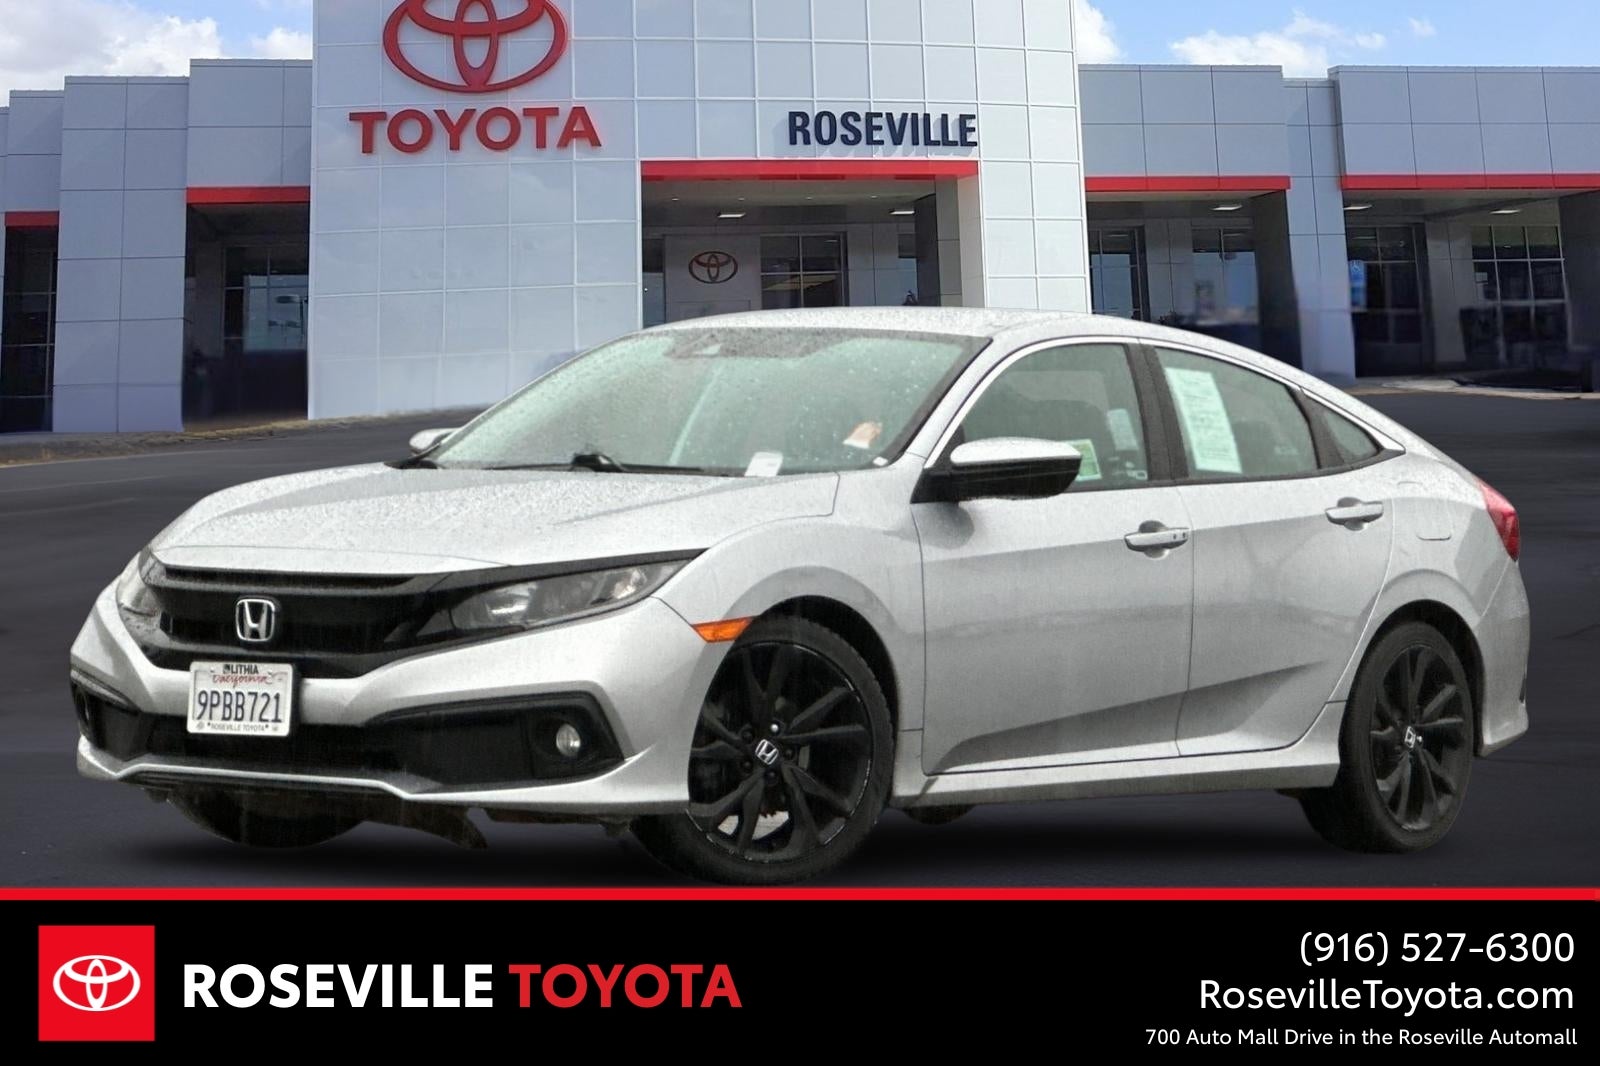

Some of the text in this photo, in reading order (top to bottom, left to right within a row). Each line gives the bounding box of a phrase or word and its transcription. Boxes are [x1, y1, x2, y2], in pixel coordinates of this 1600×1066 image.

[349, 106, 602, 153] TOYOTA
[788, 111, 978, 148] ROSEVILLE
[231, 663, 259, 675] LITHIA
[197, 690, 282, 723] 9PBB721
